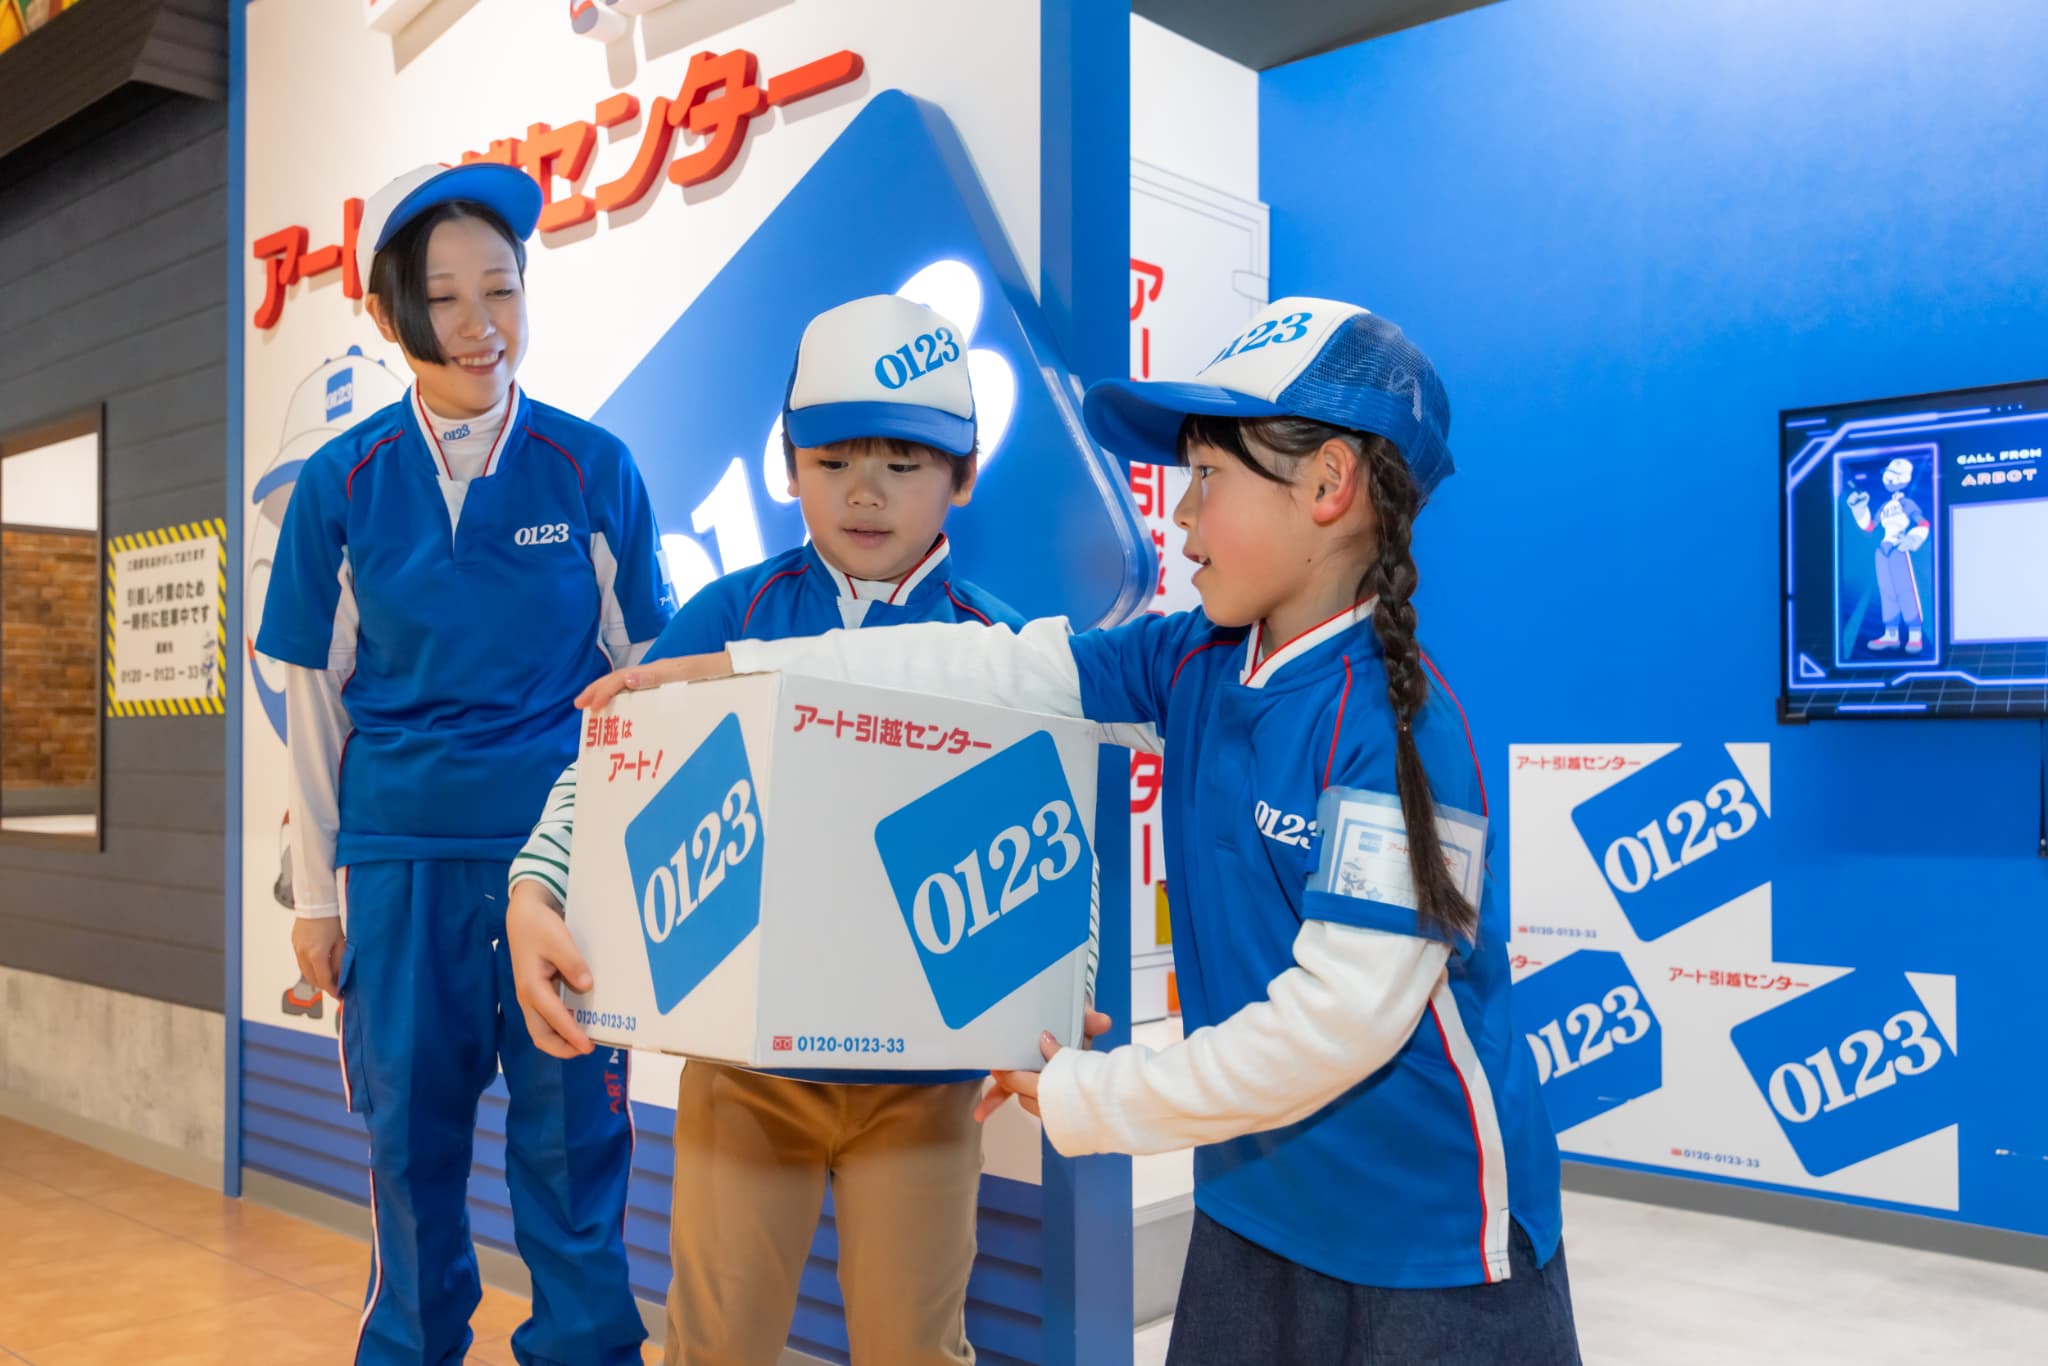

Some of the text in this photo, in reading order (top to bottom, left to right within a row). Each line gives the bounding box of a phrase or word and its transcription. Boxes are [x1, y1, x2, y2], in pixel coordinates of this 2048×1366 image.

[874, 327, 960, 390] 0123
[1196, 312, 1313, 376] 123
[443, 425, 471, 441] 0123
[1956, 447, 2042, 465] CALL FROM
[1961, 468, 2037, 487] ARBOT
[514, 523, 570, 546] 0123
[585, 715, 633, 748] 引越は
[793, 704, 993, 755] アート引越センター
[1517, 755, 1641, 771] アート引越センター
[1603, 778, 1757, 893] 0123
[642, 778, 758, 944] 0123
[912, 800, 1081, 954] 0123
[1669, 967, 1809, 991] アート引越センター
[576, 1010, 637, 1031] 0120-0123-33
[797, 1035, 905, 1054] 0120-0123-33
[1768, 1009, 1942, 1123] 0123
[604, 1061, 622, 1115] ART
